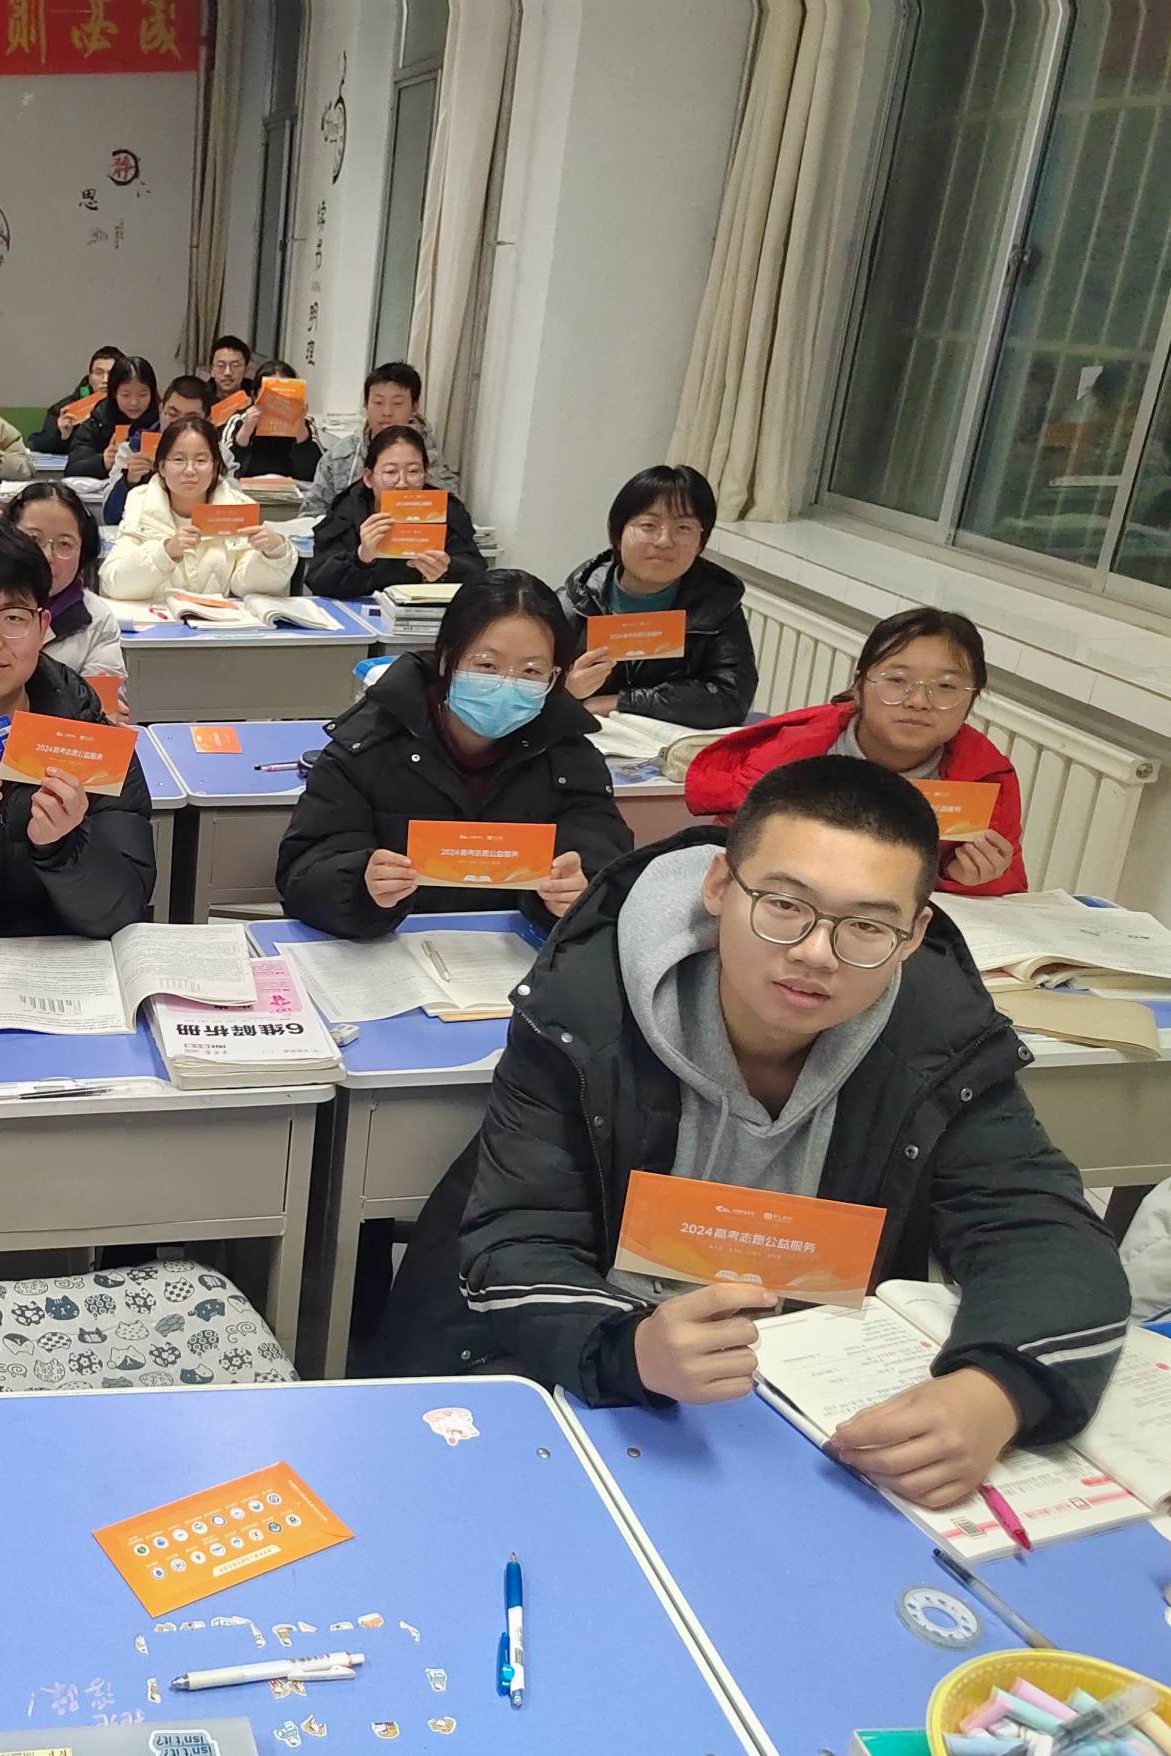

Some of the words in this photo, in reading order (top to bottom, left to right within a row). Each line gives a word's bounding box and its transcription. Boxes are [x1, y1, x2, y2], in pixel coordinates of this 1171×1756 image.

[679, 1222, 816, 1254] 2024高考志愿公益服务
[176, 1735, 205, 1746] isn't
